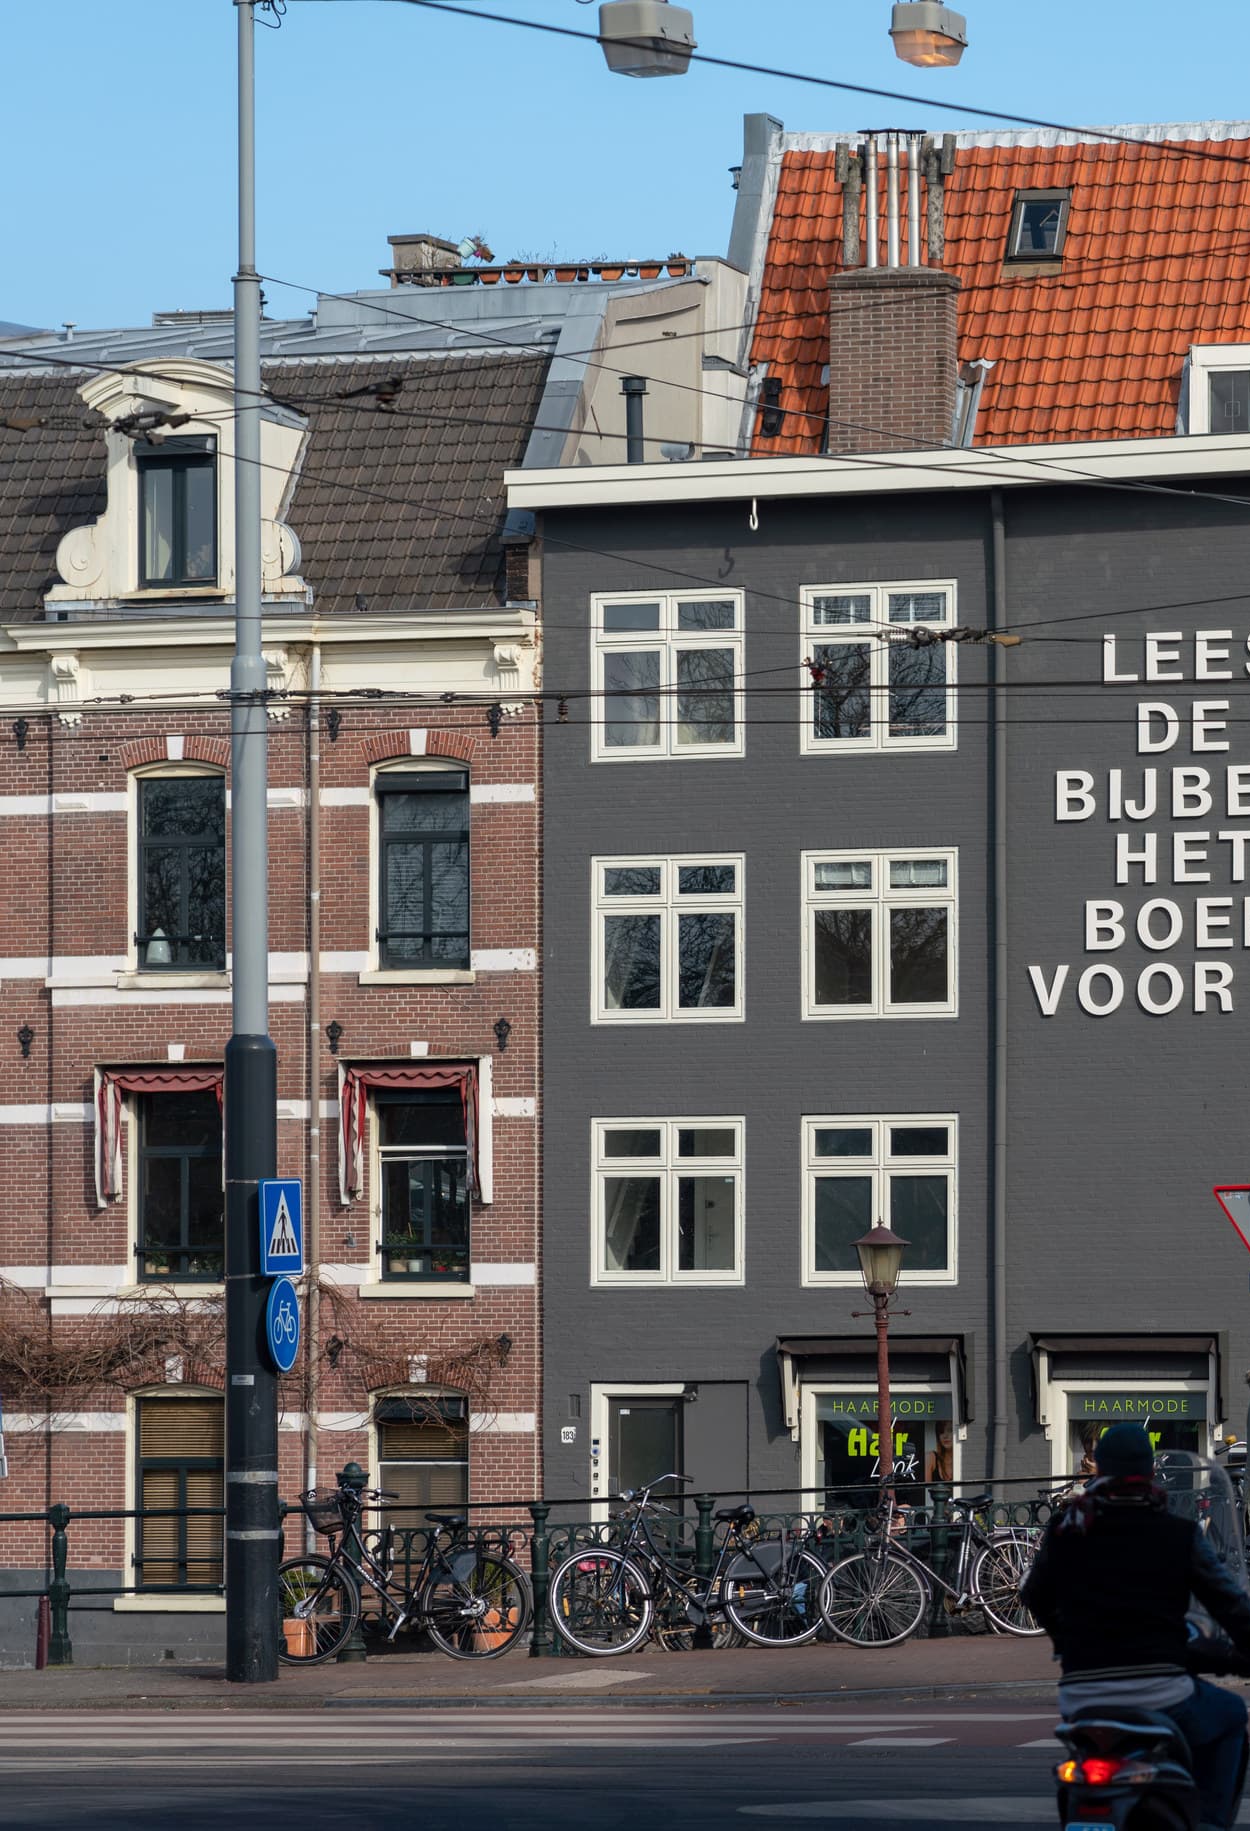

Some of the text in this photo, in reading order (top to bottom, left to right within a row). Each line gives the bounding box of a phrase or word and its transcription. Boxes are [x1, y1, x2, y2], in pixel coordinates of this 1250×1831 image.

[1137, 700, 1230, 753] DE
[1028, 960, 1234, 1016] VOOR
[1084, 1399, 1190, 1412] HAARMODE
[562, 1431, 573, 1440] 183
[847, 1428, 909, 1456] Har
